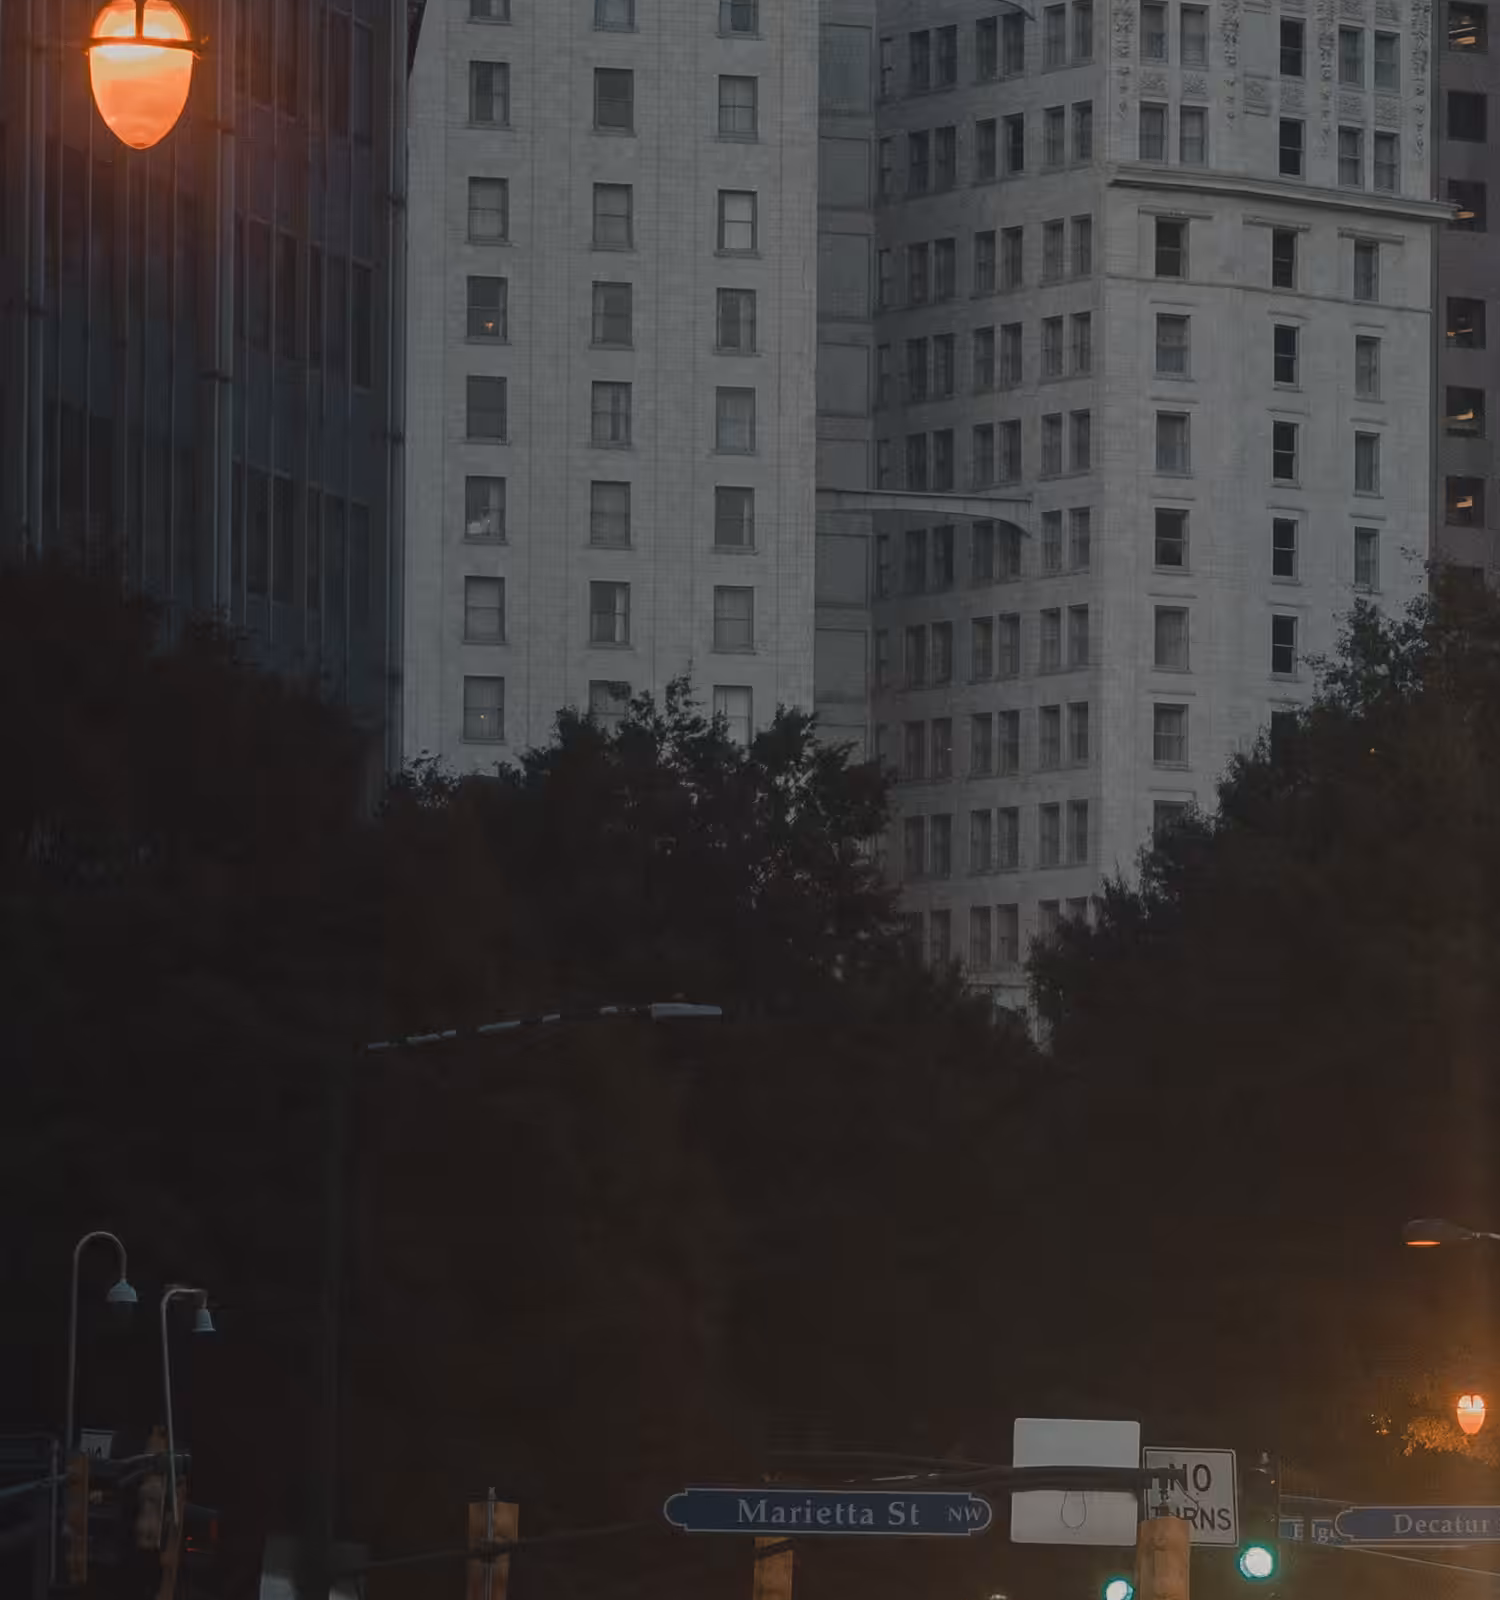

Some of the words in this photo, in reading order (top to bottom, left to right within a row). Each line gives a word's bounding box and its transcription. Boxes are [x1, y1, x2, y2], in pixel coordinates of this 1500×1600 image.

[1169, 1463, 1212, 1492] NO
[736, 1498, 875, 1526] Marietta
[887, 1500, 920, 1526] St
[947, 1505, 985, 1523] NW
[1151, 1505, 1232, 1531] RNS
[1392, 1513, 1491, 1535] Decatur
